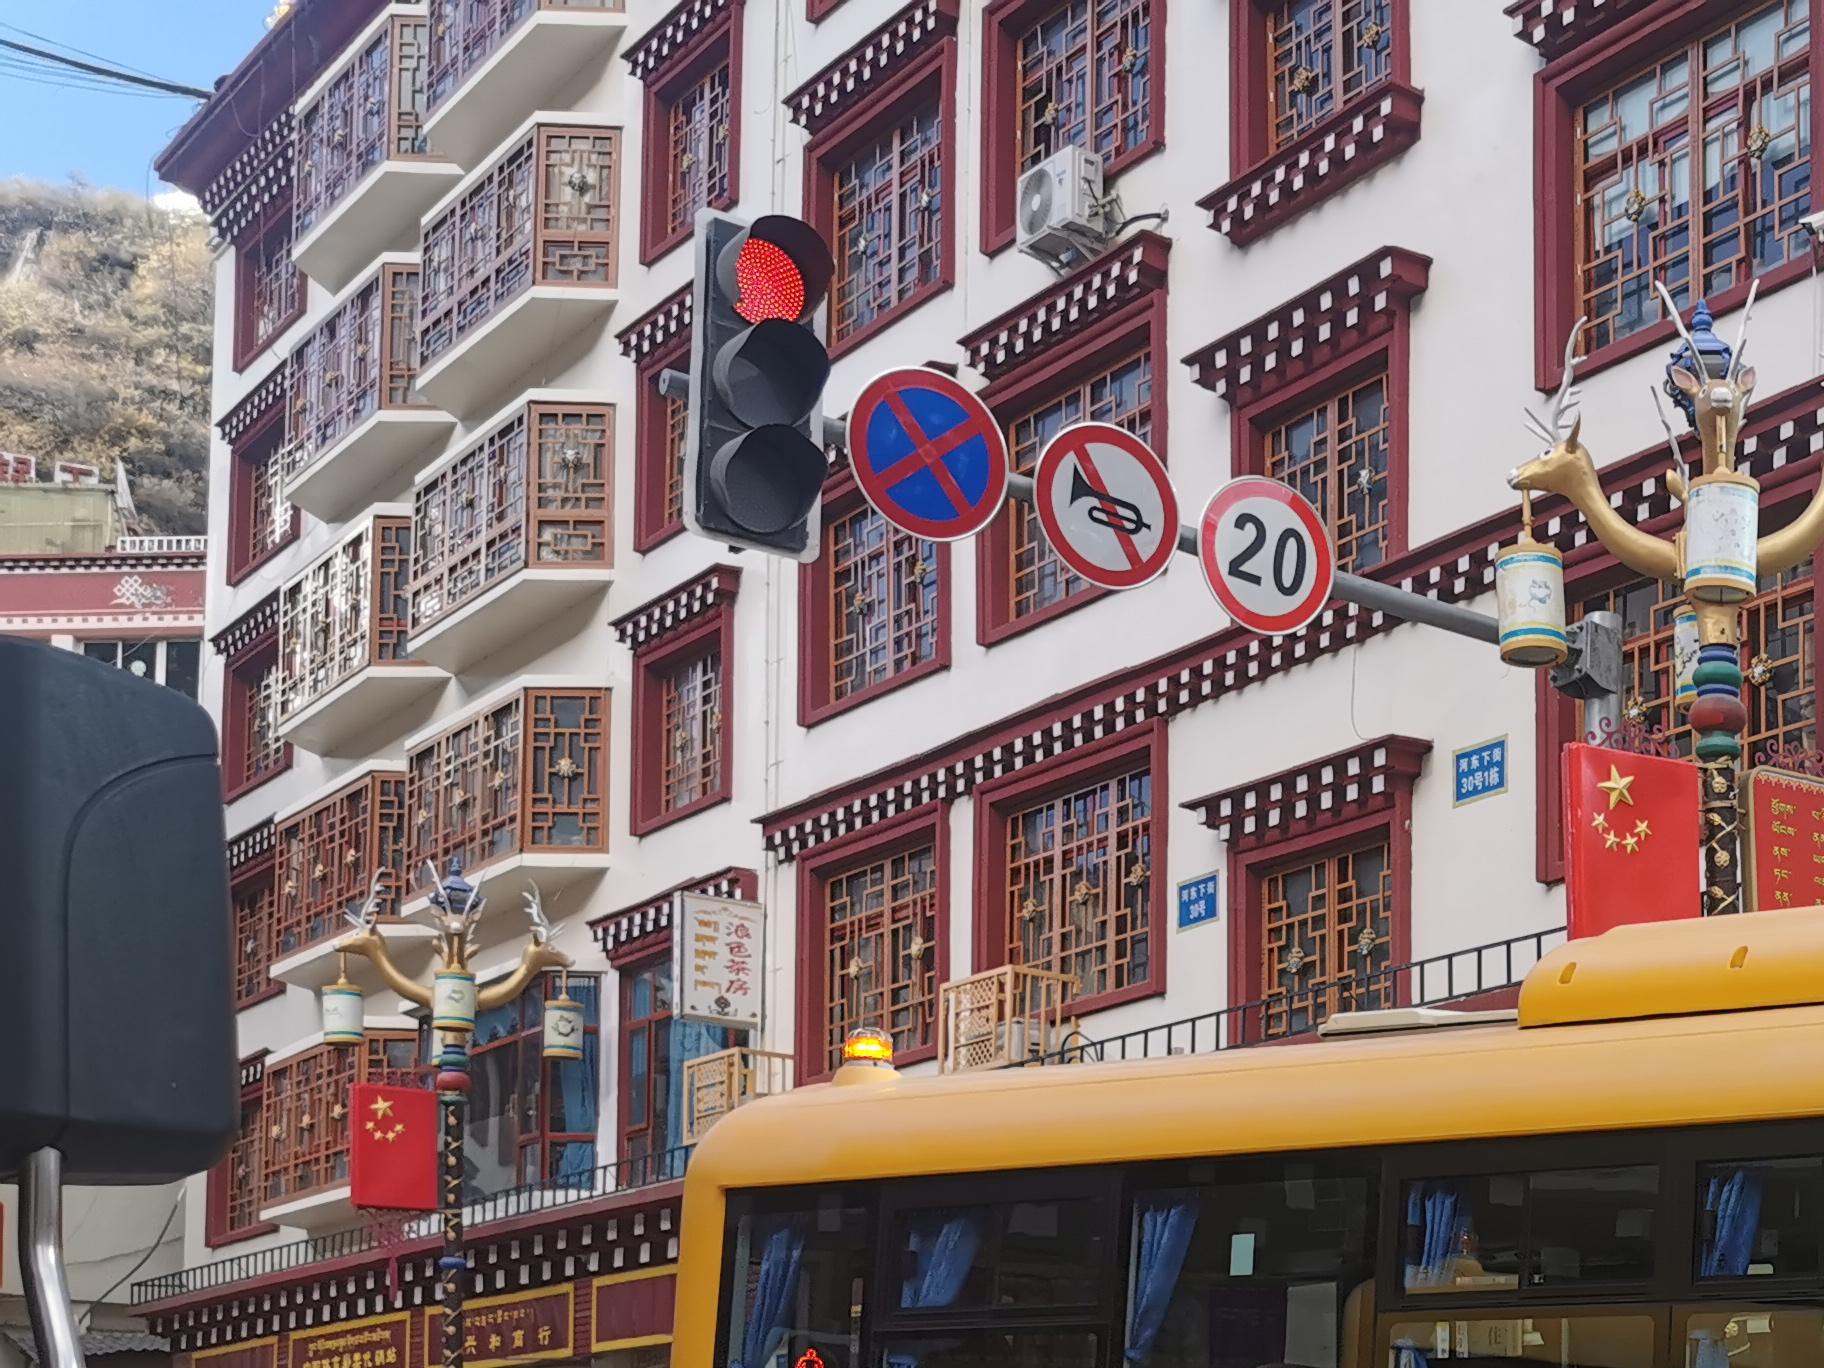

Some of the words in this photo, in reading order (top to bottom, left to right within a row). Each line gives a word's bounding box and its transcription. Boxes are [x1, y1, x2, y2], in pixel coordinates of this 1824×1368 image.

[1227, 512, 1307, 597] 20
[1459, 747, 1502, 773] 河东下街
[1461, 766, 1500, 794] 30号1栋
